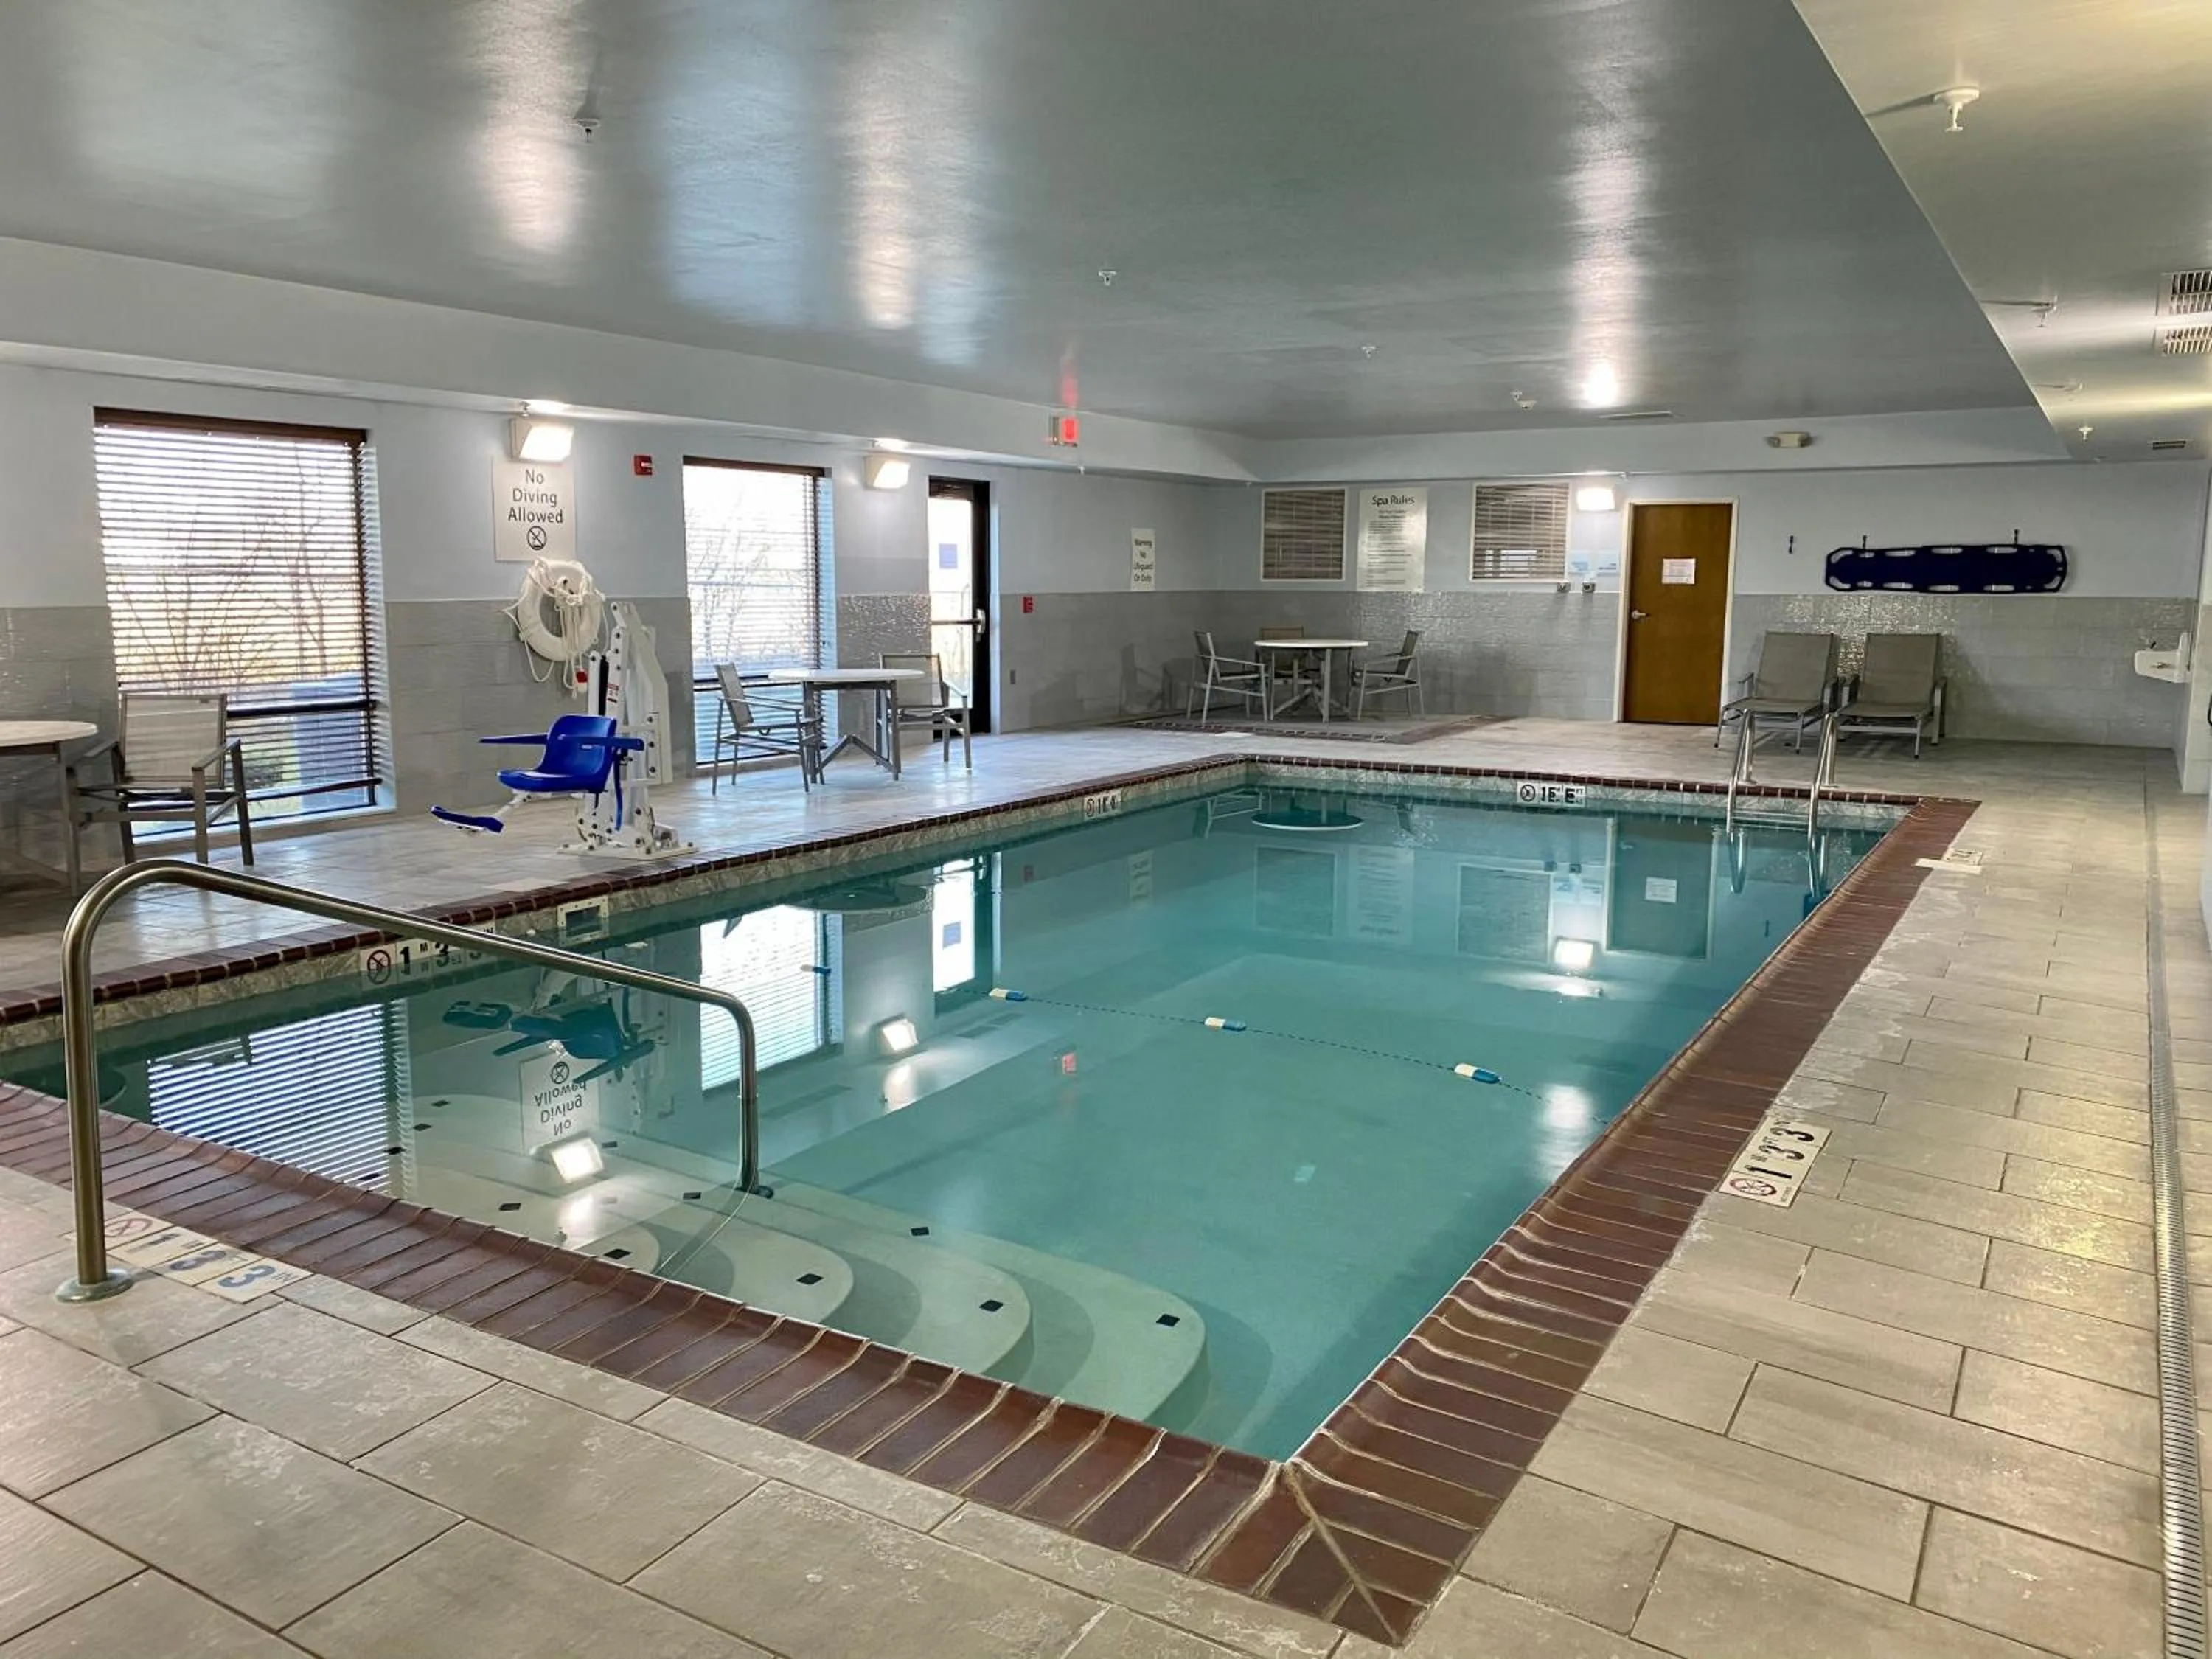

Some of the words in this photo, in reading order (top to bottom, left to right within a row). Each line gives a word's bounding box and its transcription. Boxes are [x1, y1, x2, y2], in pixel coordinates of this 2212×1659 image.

[525, 469, 544, 483] No
[512, 488, 557, 507] Diving
[1371, 495, 1388, 507] Spa
[1390, 495, 1415, 504] Rules
[508, 507, 564, 524] Allowed
[1770, 1127, 1815, 1142] 3
[1758, 1144, 1805, 1161] 3
[169, 1249, 226, 1271] 3
[217, 1265, 276, 1288] 3
